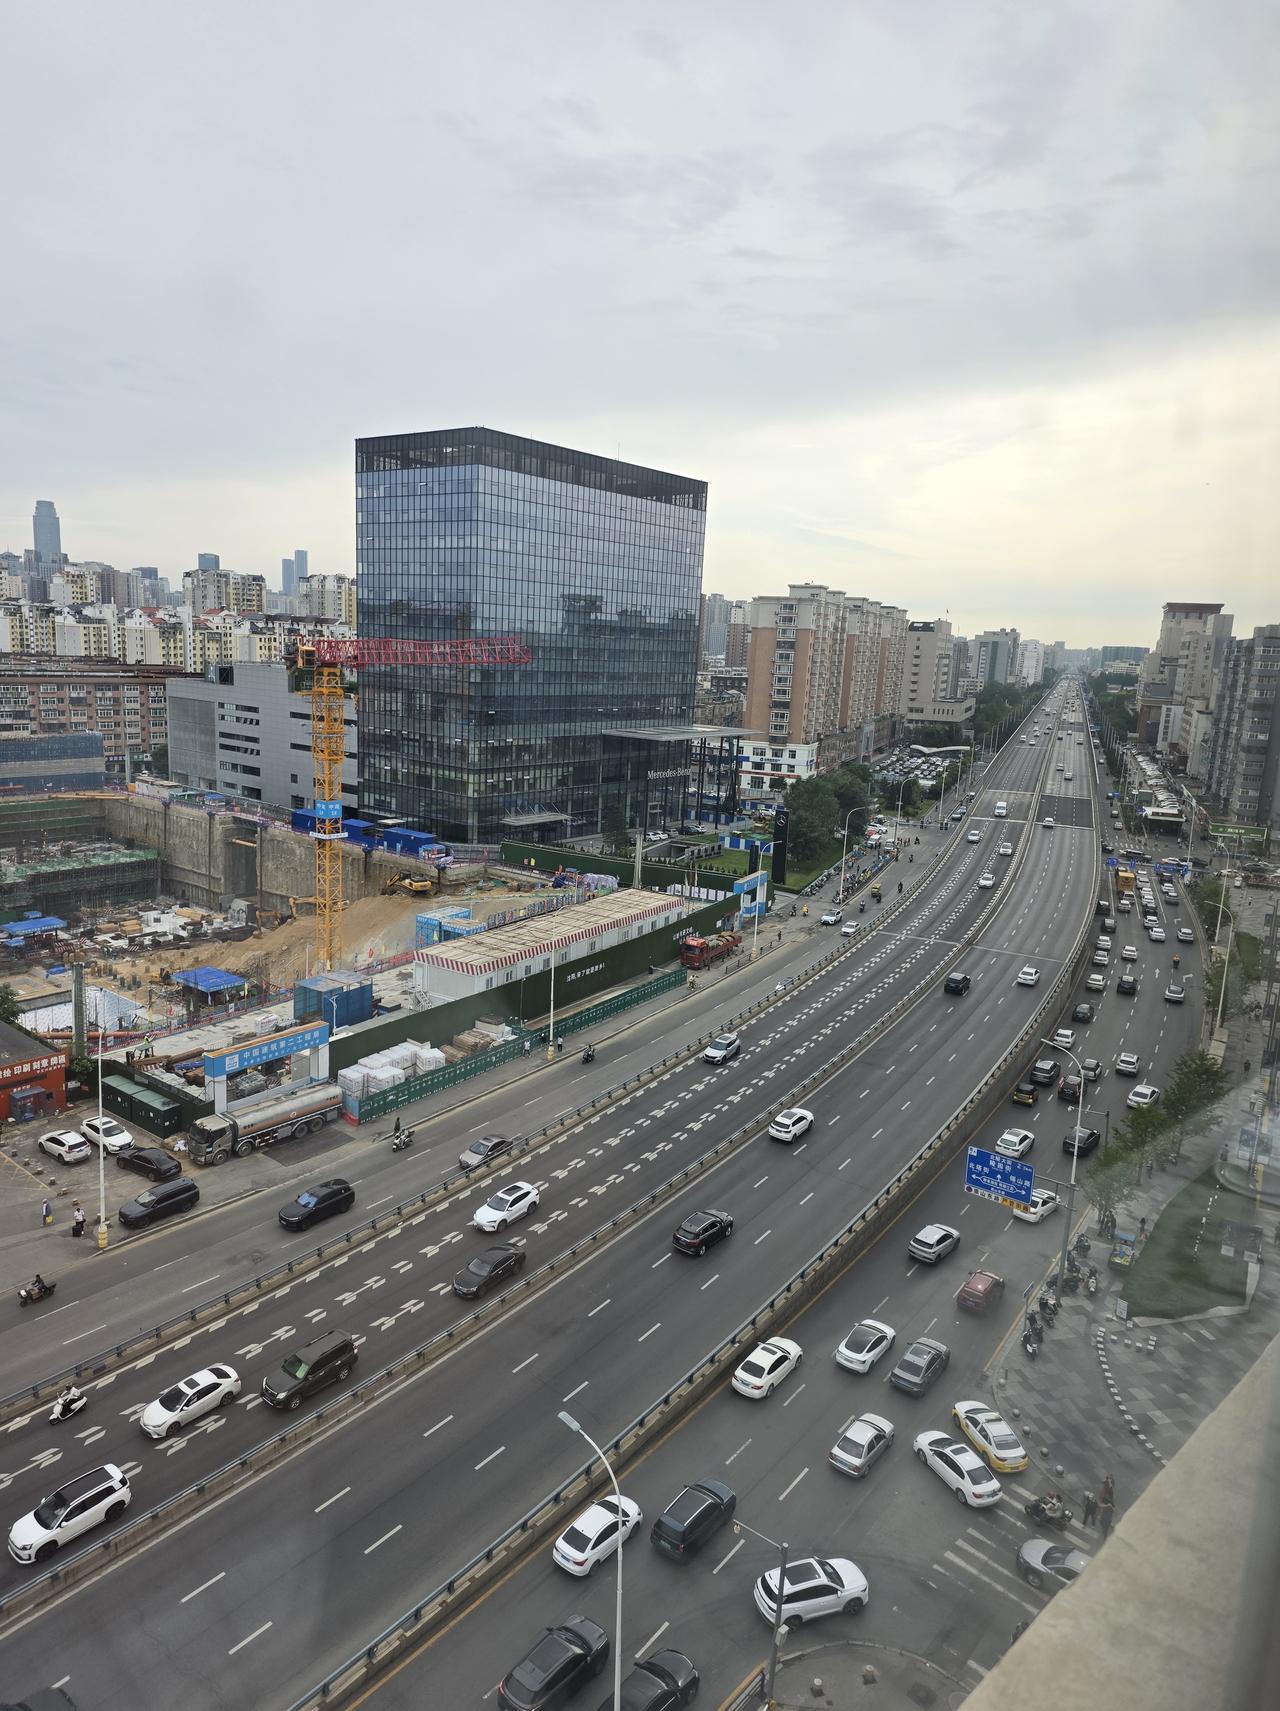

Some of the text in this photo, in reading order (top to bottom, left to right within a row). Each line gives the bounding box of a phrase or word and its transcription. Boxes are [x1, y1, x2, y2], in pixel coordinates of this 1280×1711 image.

[243, 1030, 320, 1060] 中国建筑第二工程局
[14, 1063, 31, 1075] 印刷
[969, 1162, 990, 1174] 北塔街
